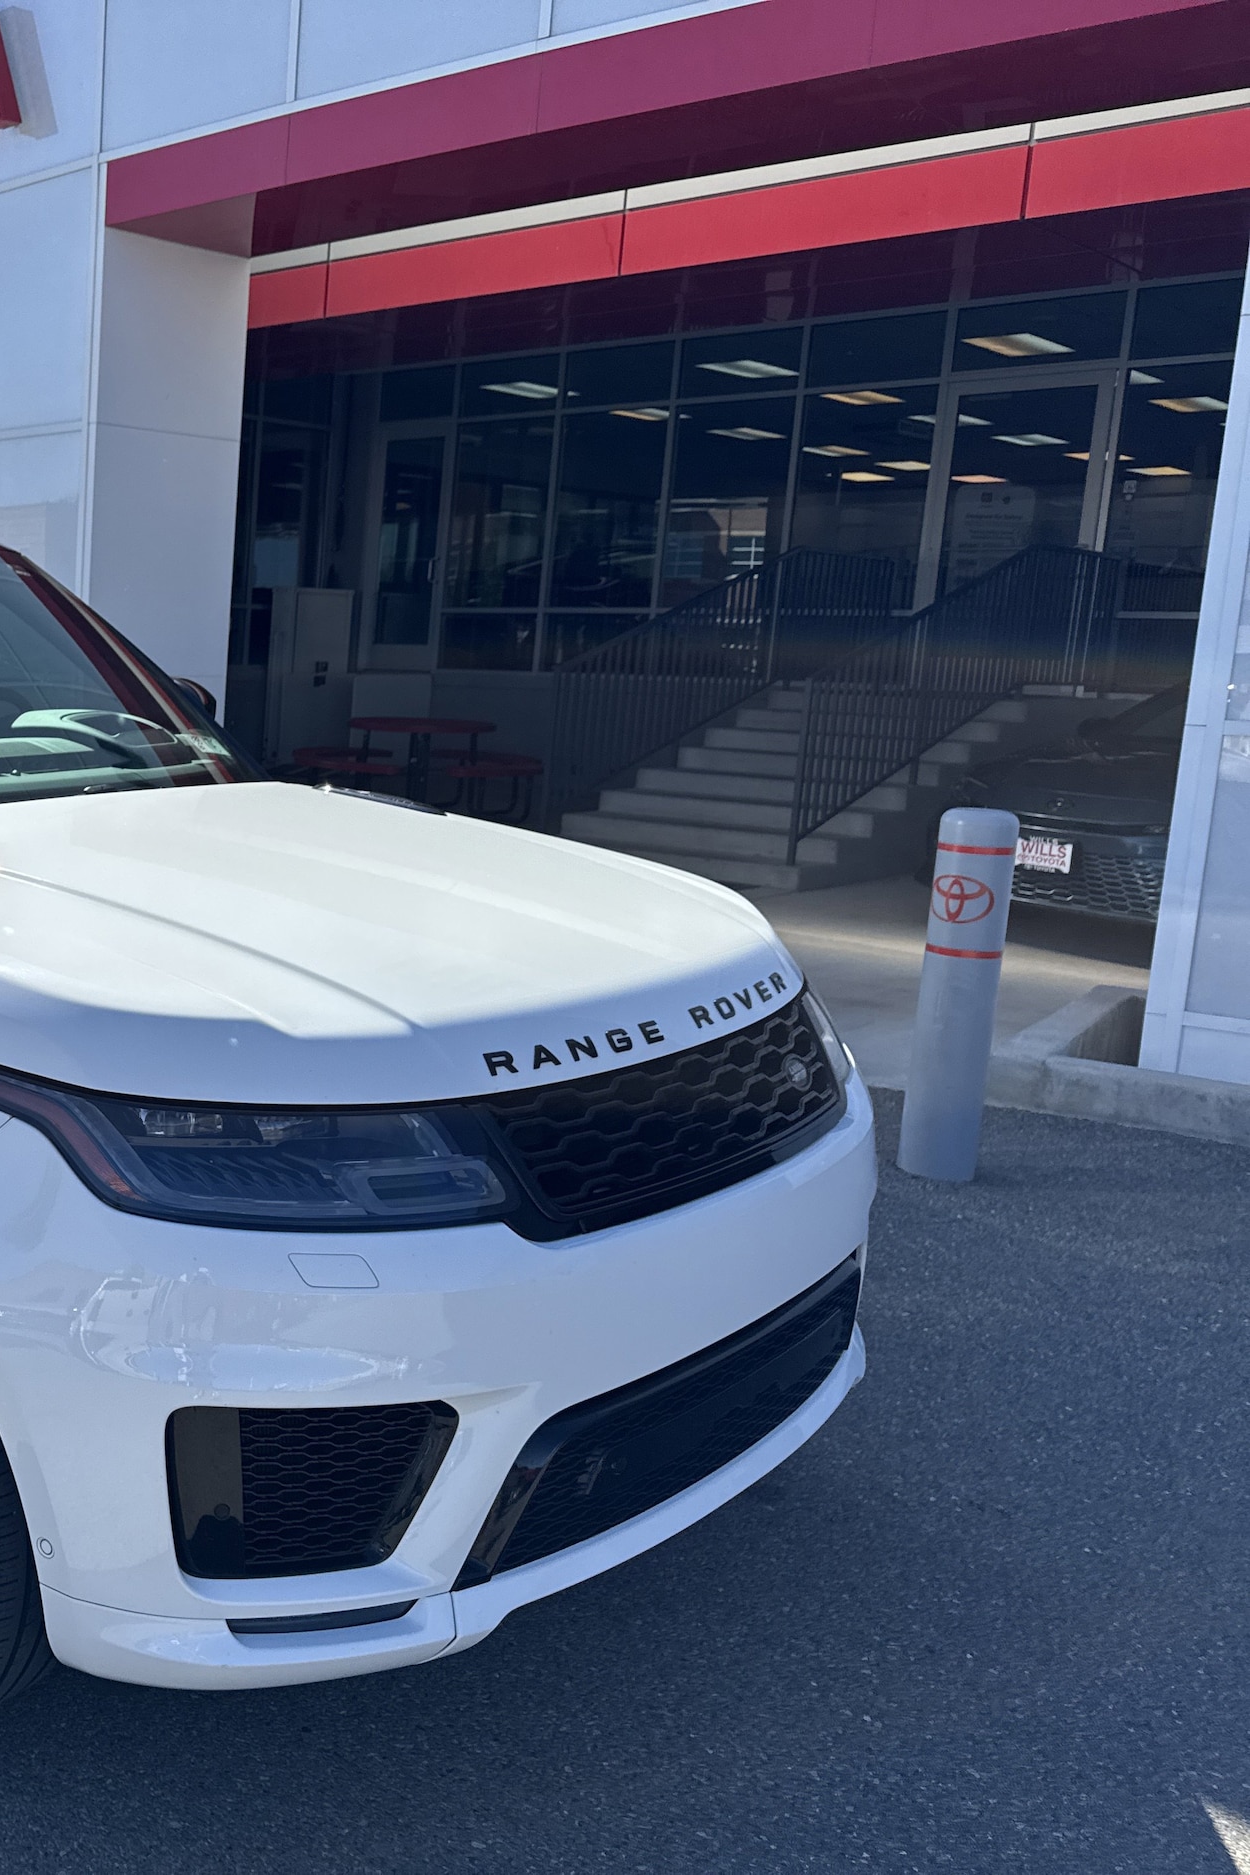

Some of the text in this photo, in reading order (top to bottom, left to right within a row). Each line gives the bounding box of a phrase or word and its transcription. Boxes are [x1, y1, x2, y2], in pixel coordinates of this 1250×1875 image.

[1021, 841, 1066, 859] WILLS
[1031, 854, 1066, 867] TOYOTA
[483, 971, 788, 1077] RANGE ROVER
